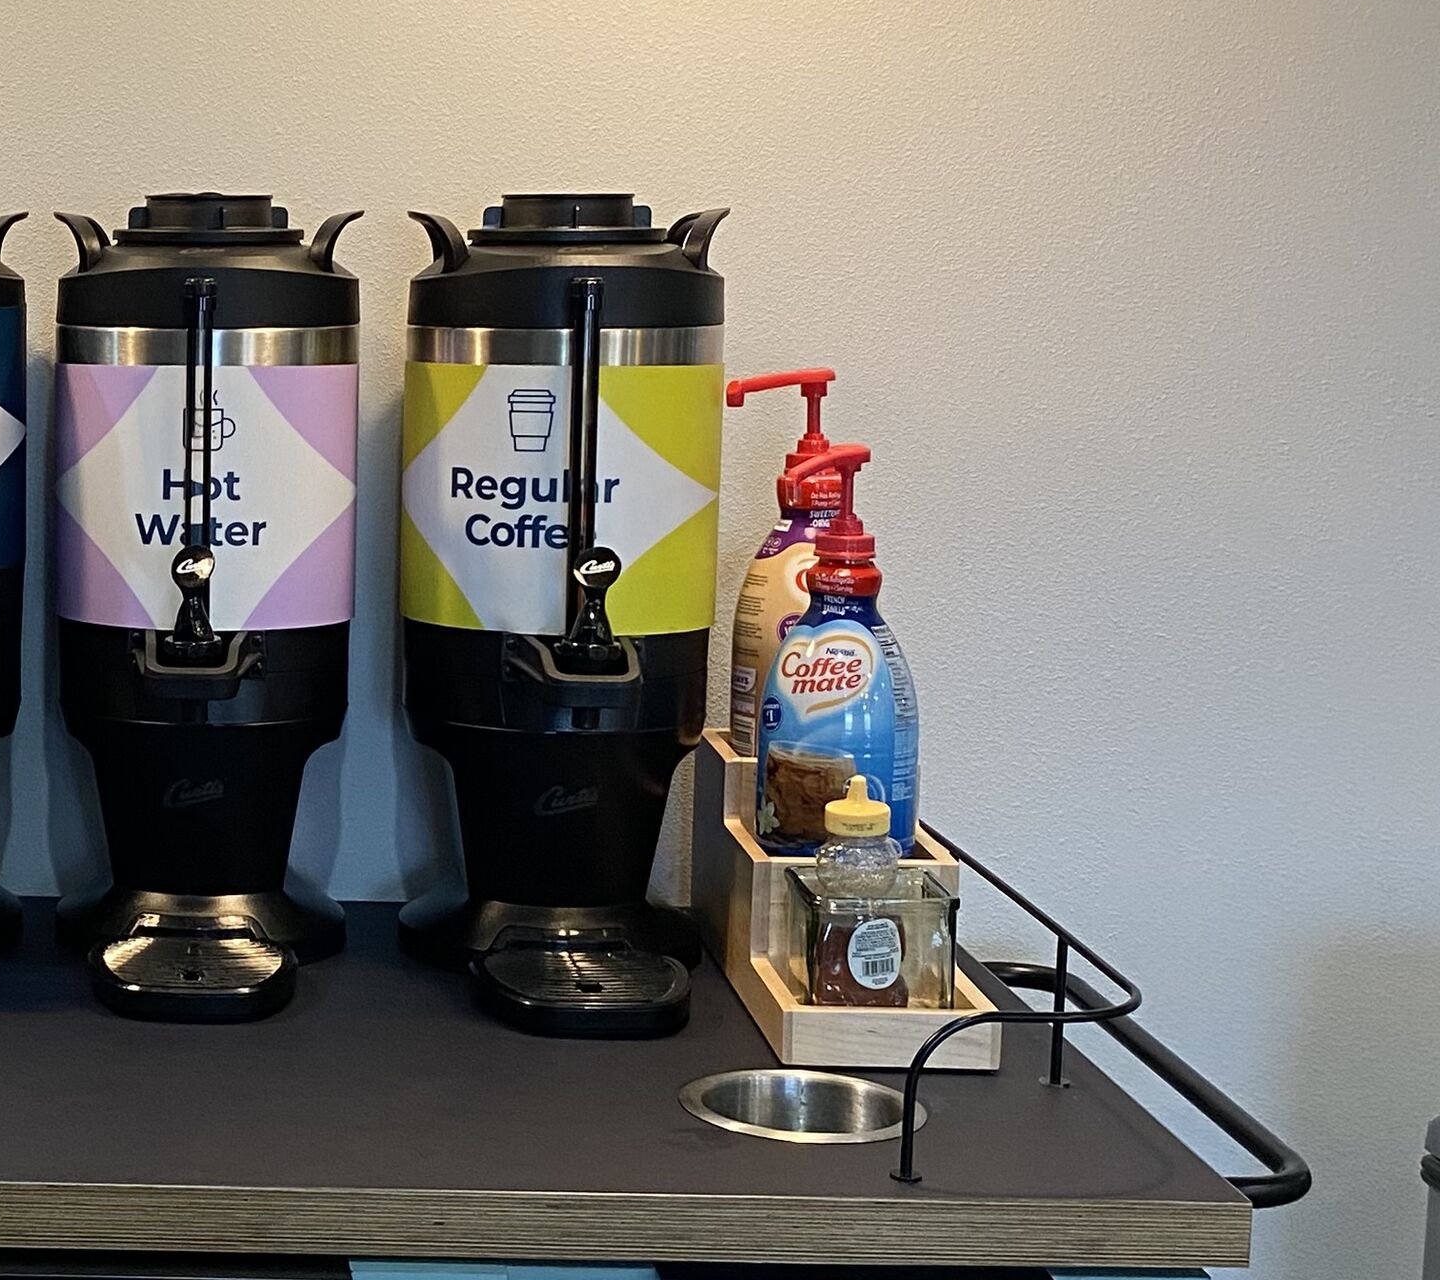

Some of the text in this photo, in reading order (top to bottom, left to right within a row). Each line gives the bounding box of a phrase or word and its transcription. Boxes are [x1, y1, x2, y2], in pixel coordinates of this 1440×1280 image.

[451, 466, 620, 511] Regulr
[135, 513, 267, 546] Wter
[465, 513, 597, 550] Coffe
[781, 651, 862, 679] Coffee
[791, 673, 861, 694] mate
